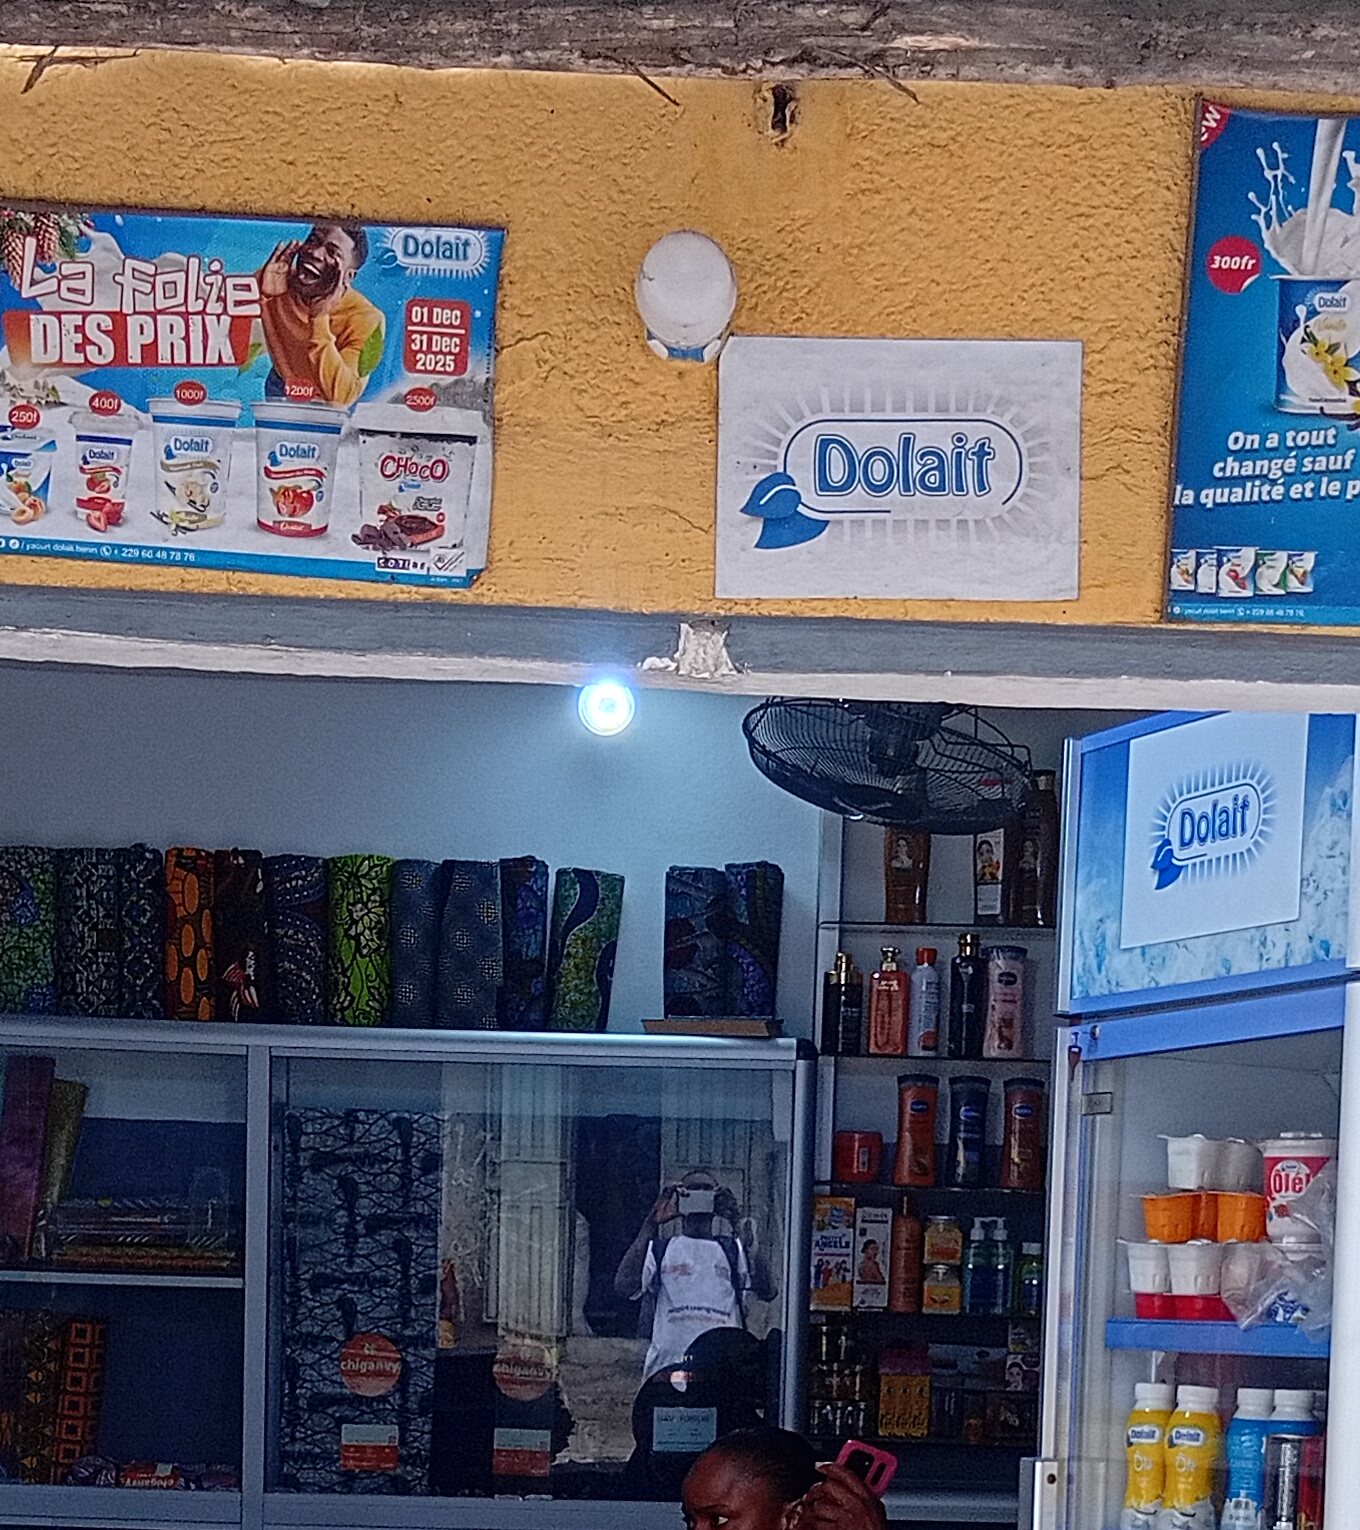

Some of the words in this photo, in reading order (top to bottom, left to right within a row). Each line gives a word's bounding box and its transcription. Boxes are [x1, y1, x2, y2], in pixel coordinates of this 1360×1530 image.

[402, 232, 471, 264] Dolait
[1210, 255, 1257, 271] 300fr
[411, 306, 428, 323] 01
[30, 313, 116, 364] DES
[127, 314, 236, 365] PRIX
[411, 335, 428, 351] 31
[414, 354, 455, 372] 2025
[92, 398, 118, 410] 400f
[11, 411, 37, 423] 250f
[174, 438, 209, 452] Dolait
[1227, 430, 1260, 451] On
[1265, 432, 1279, 449] a
[1286, 427, 1337, 448] tout
[280, 445, 316, 459] Dolait
[815, 432, 994, 497] Dolait
[1213, 451, 1297, 480] changé
[1301, 449, 1357, 472] sauf
[1174, 484, 1194, 506] la
[1200, 479, 1285, 509] qualité
[1289, 481, 1314, 499] et
[1319, 476, 1341, 498] le
[1179, 794, 1249, 850] Dolait
